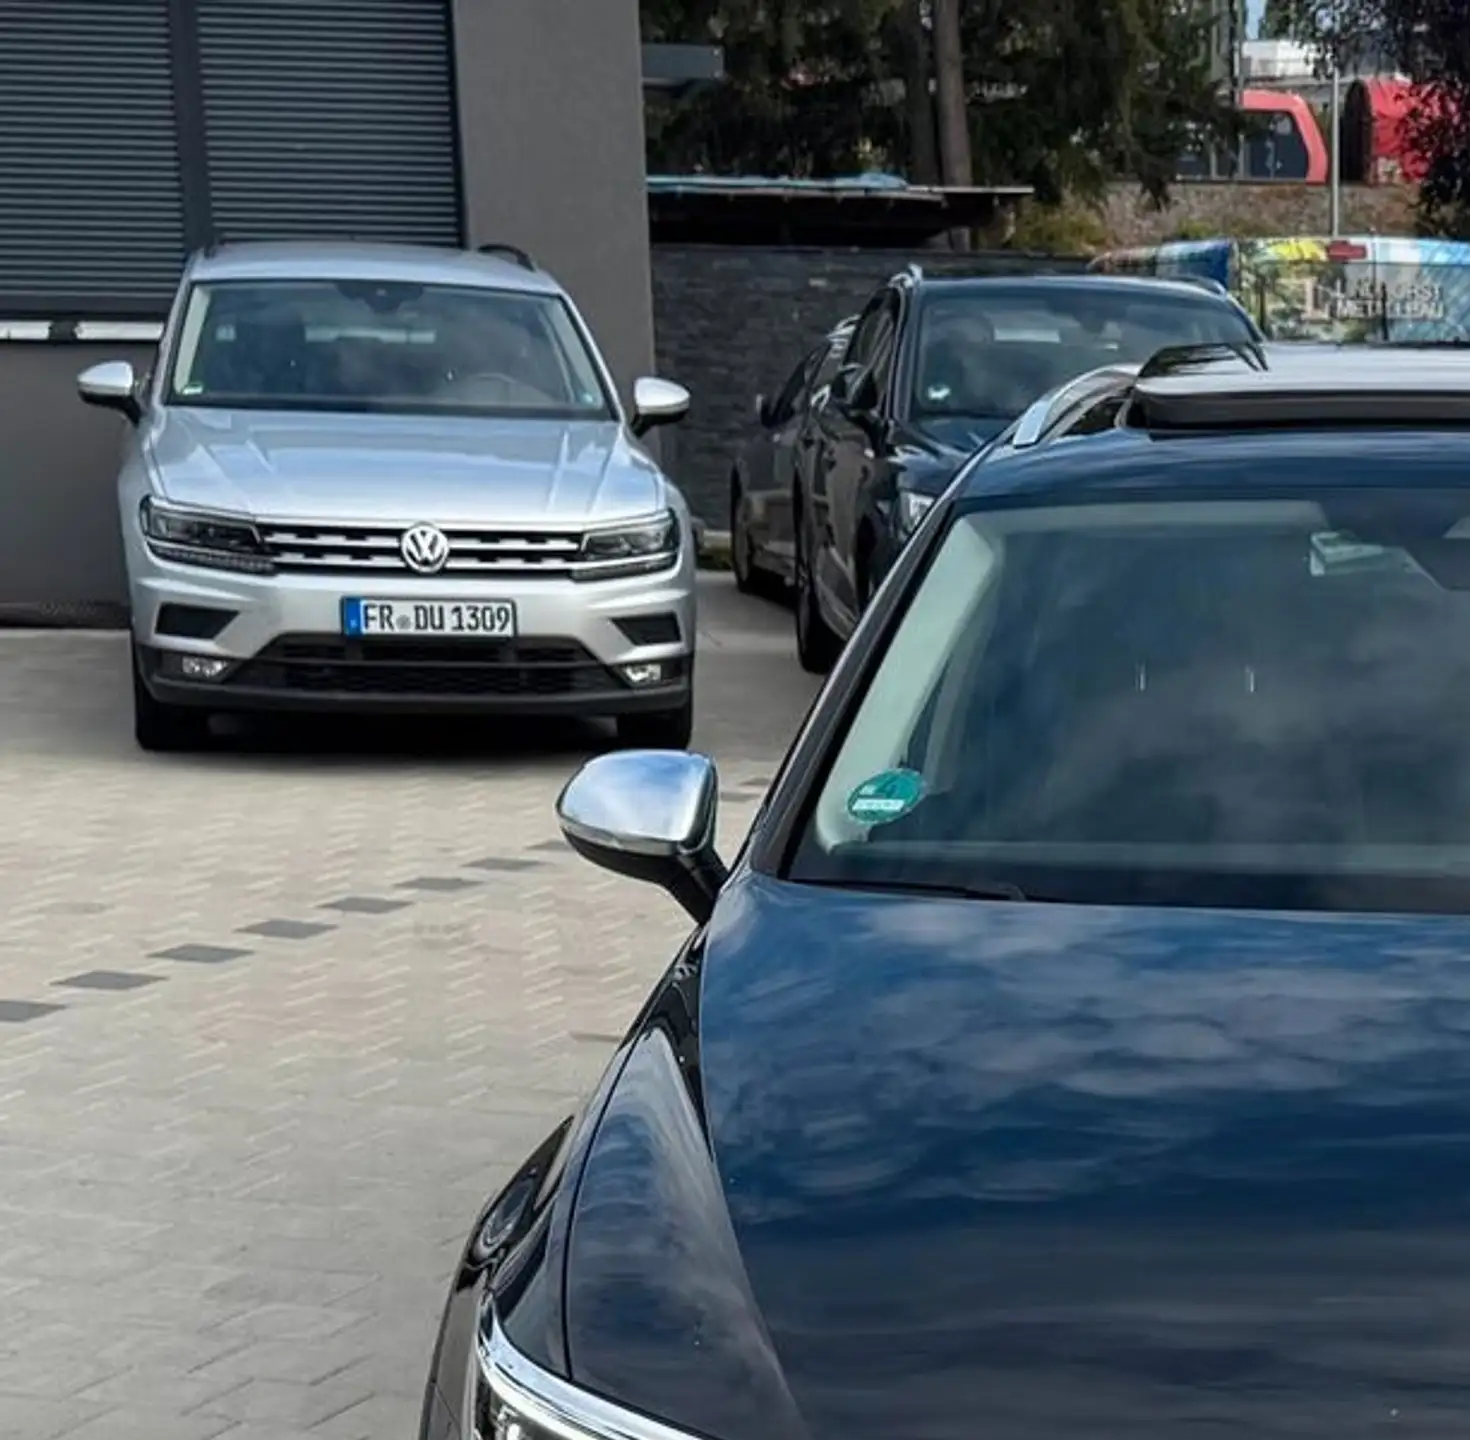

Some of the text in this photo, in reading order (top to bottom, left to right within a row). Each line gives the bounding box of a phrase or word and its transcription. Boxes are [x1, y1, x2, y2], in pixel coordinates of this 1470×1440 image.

[363, 604, 510, 632] FR DU 1309
